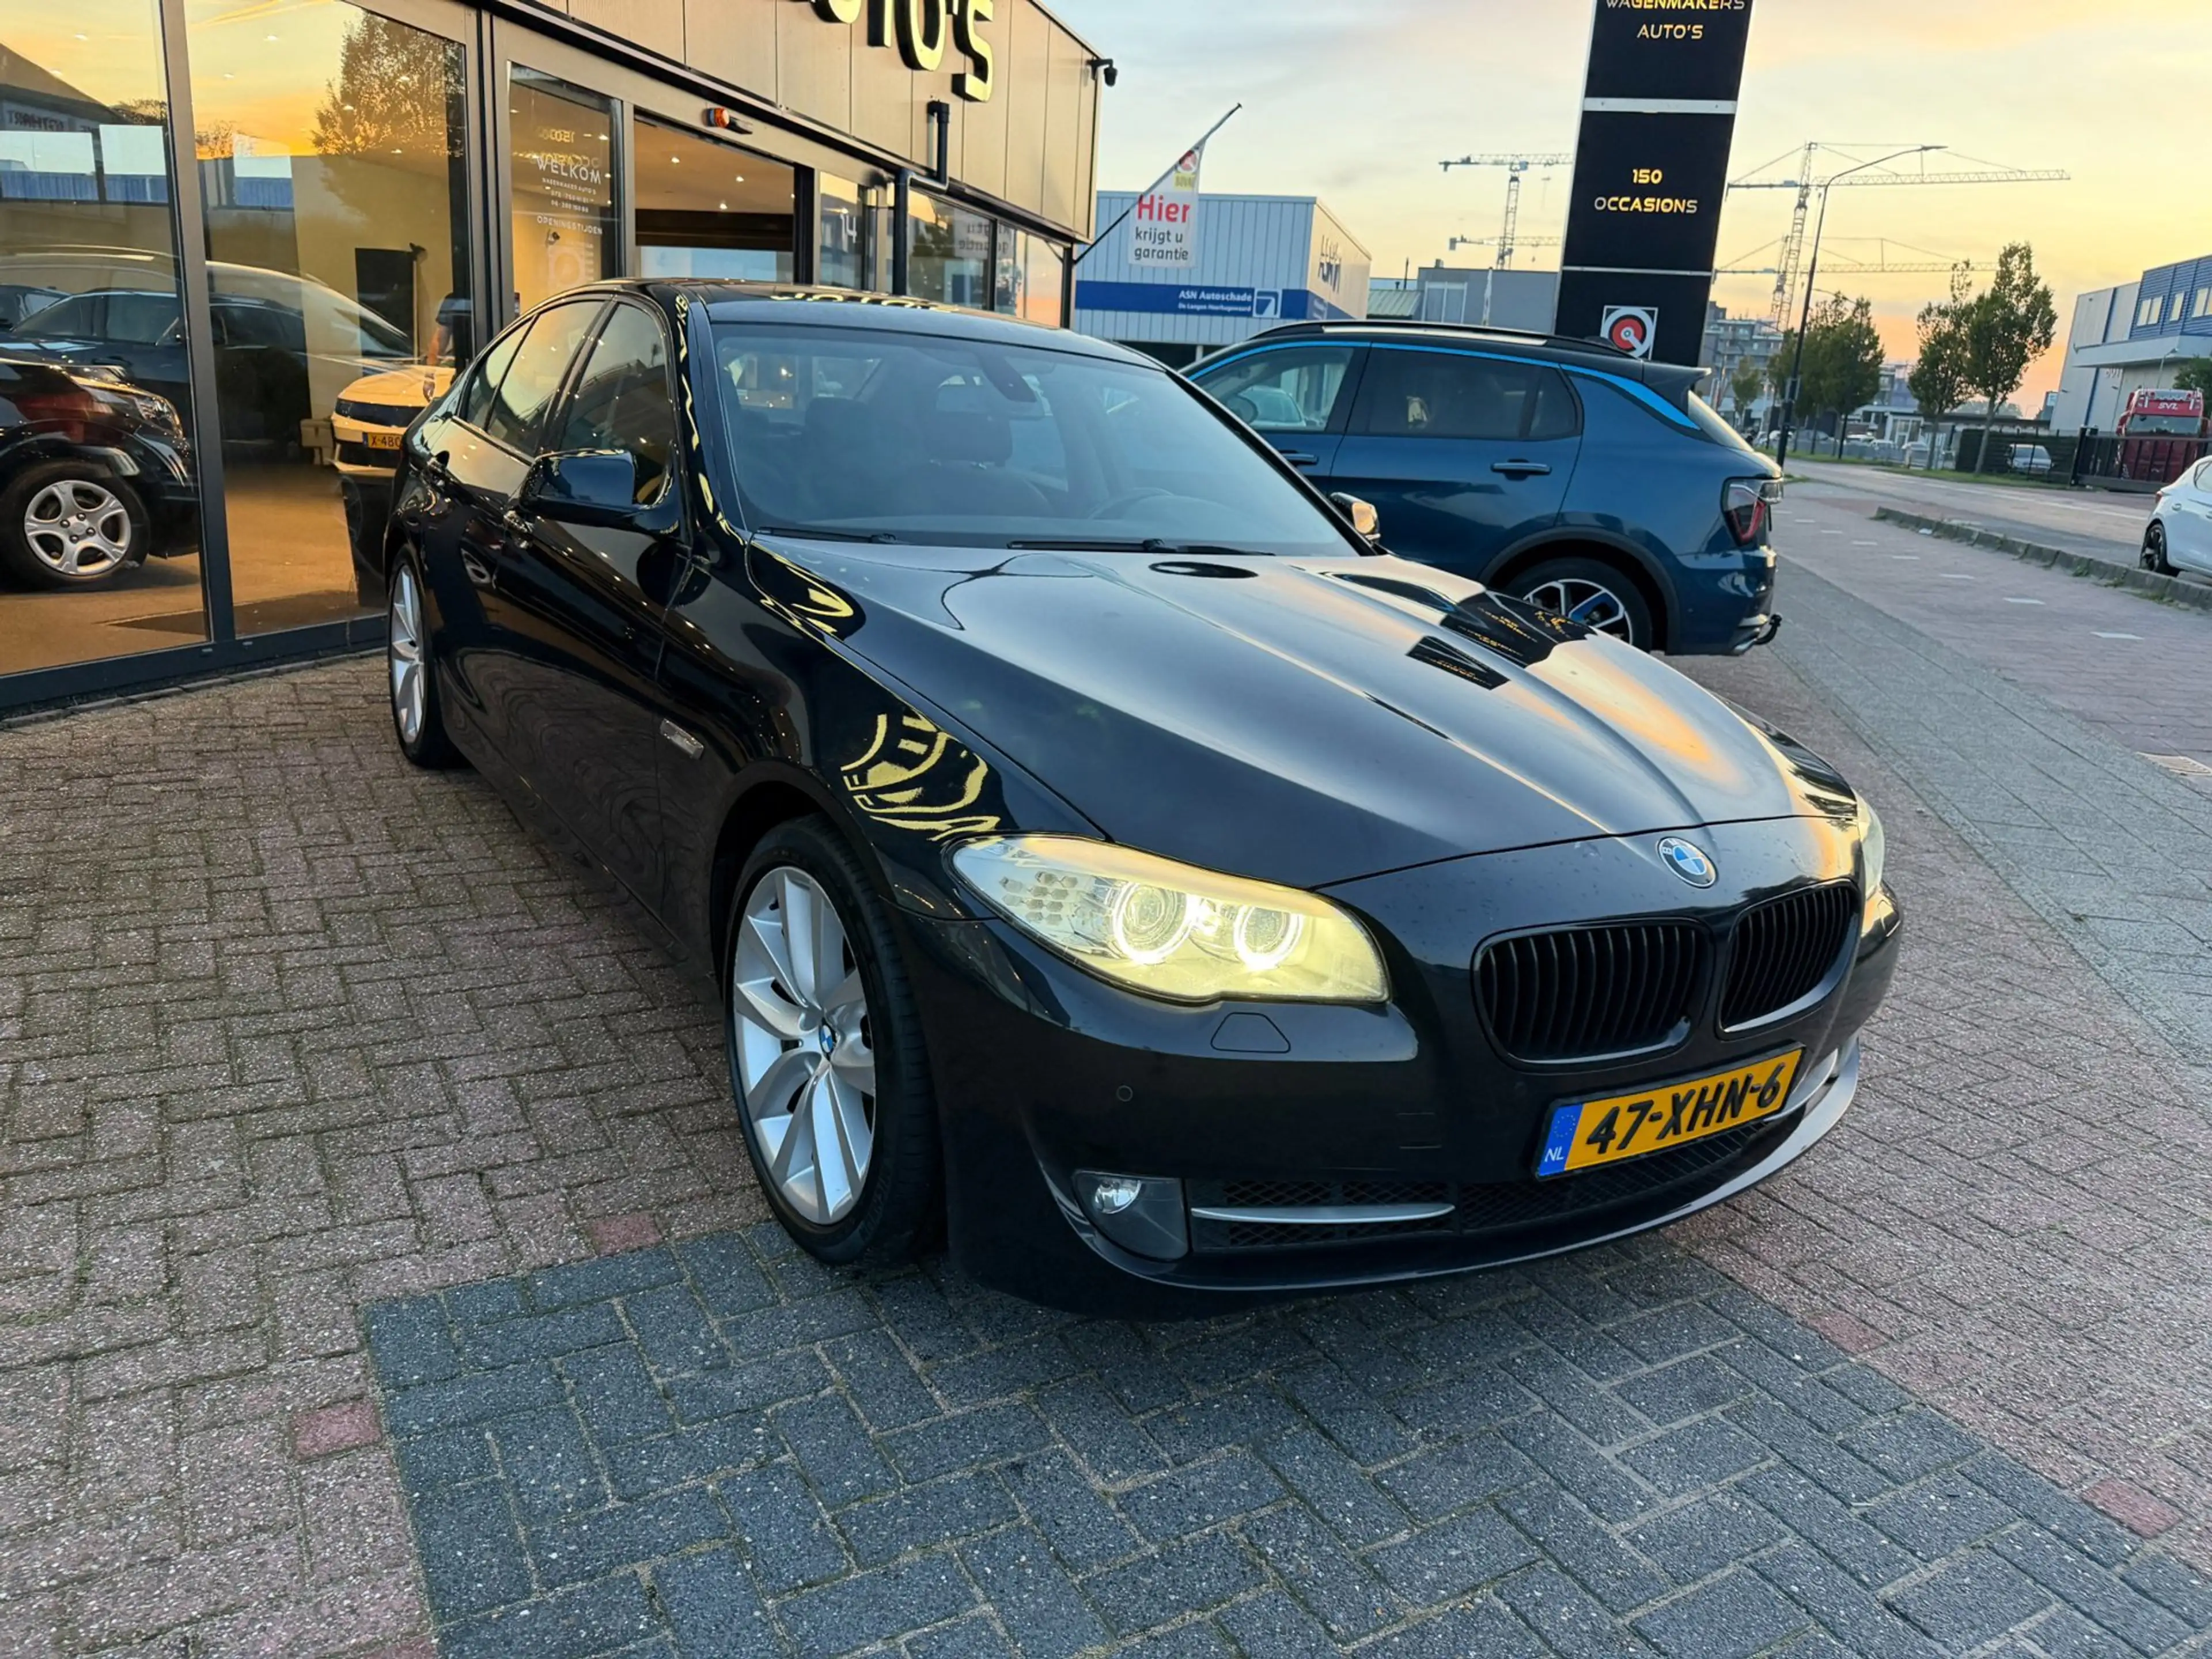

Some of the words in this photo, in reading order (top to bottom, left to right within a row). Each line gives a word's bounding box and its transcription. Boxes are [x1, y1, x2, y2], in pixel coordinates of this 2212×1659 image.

[1637, 24, 1703, 39] AUTO'S
[536, 157, 601, 184] WELKOM
[1633, 169, 1662, 184] 150
[1138, 194, 1191, 223] Hier
[1594, 197, 1698, 213] OCCASIONS
[1135, 227, 1171, 244] krijgt
[1176, 233, 1183, 243] u
[1135, 247, 1188, 260] garantie
[1179, 290, 1197, 300] ASN
[1199, 291, 1252, 301] Autoschade
[1586, 1062, 1785, 1154] 47-XHN-6
[1544, 1146, 1564, 1162] NL
